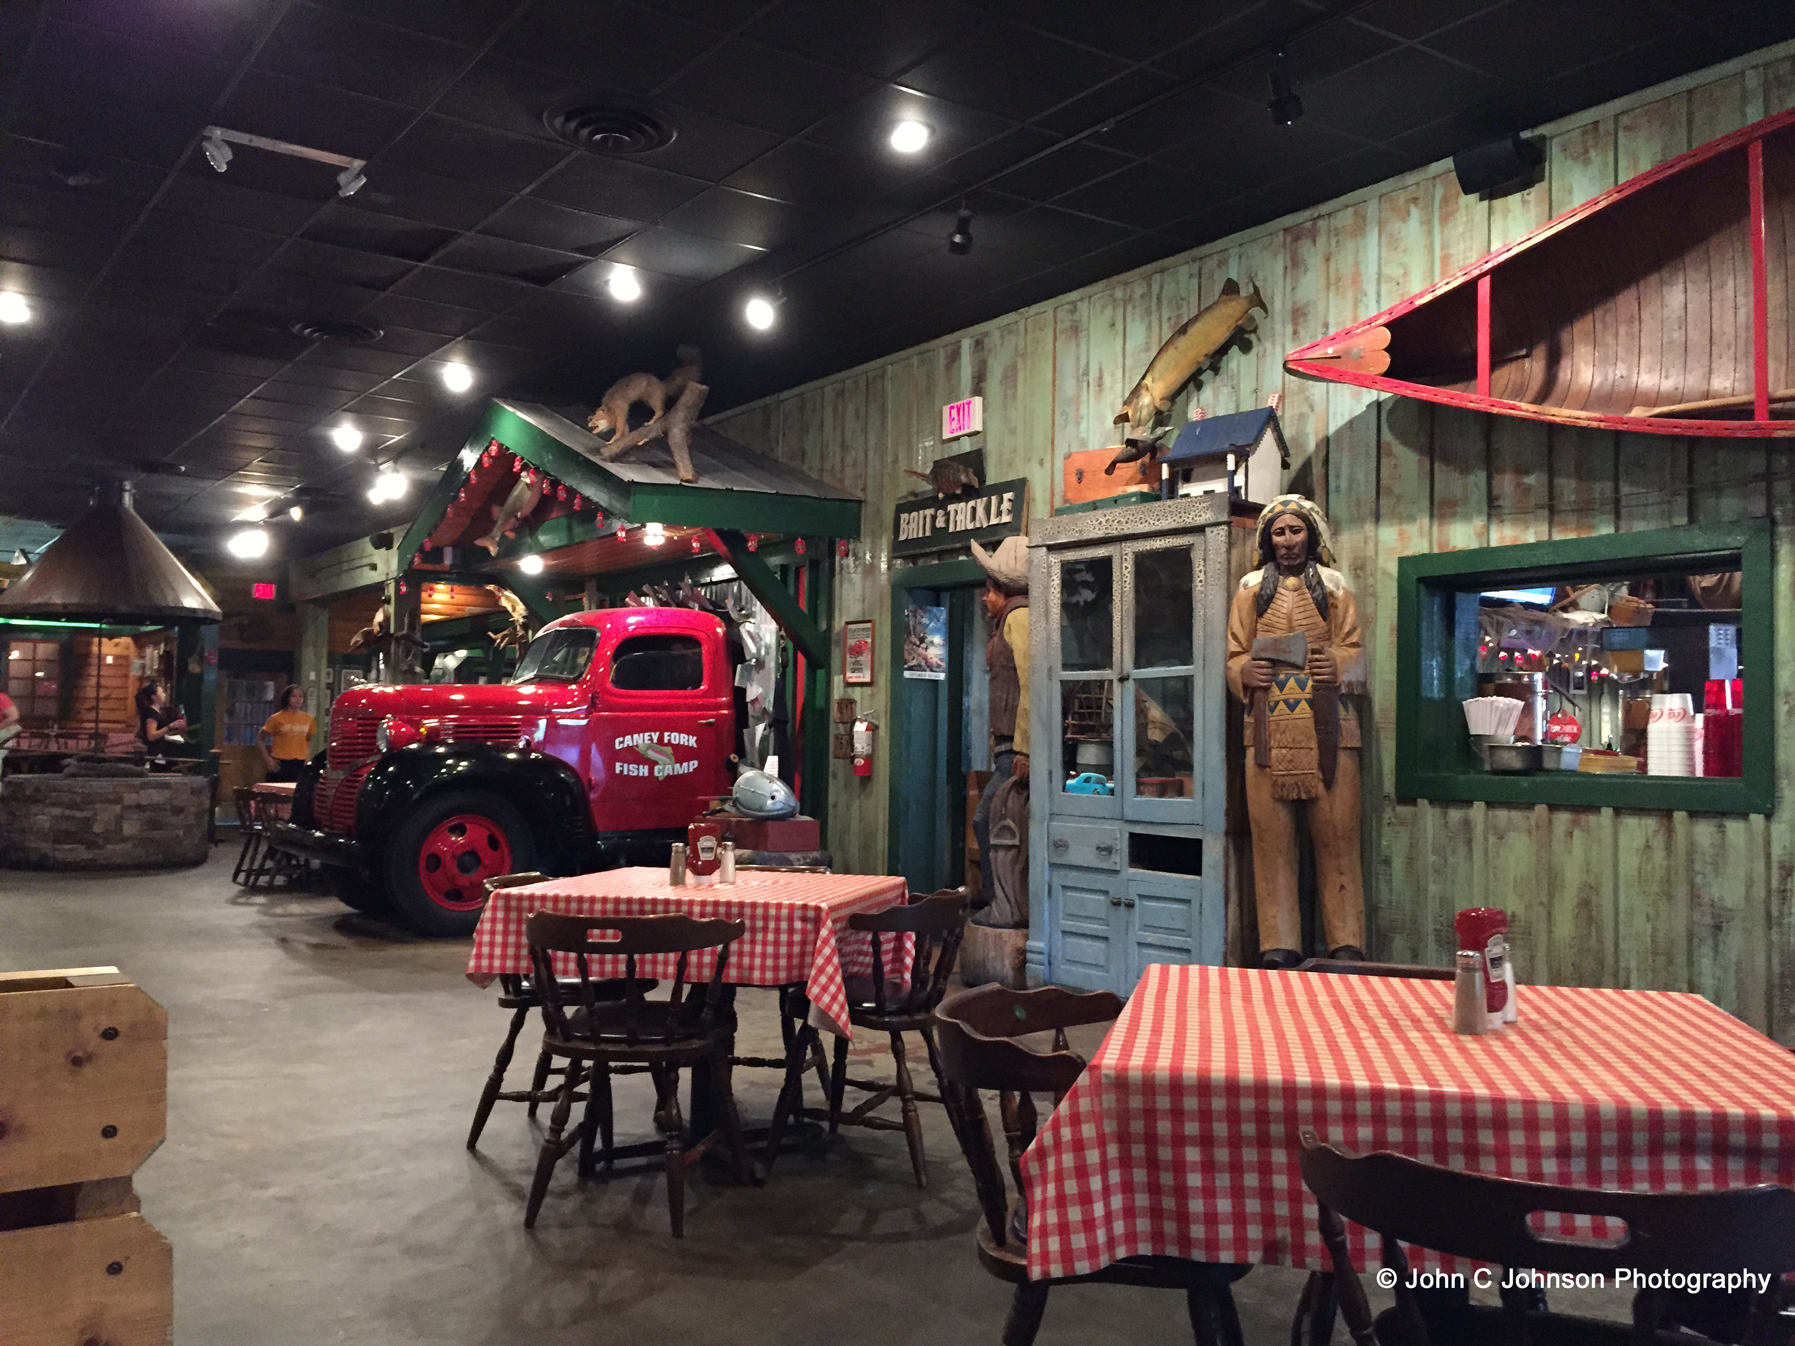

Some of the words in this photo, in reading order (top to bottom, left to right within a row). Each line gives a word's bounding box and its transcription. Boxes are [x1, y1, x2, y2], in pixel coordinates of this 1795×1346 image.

[948, 400, 972, 434] EXIT
[898, 508, 935, 541] BAIT
[935, 509, 947, 528] &
[947, 491, 1014, 533] TACKLE
[615, 732, 660, 750] CANEY
[664, 731, 698, 748] FORK
[615, 762, 649, 777] FISH
[654, 760, 699, 777] CAMP
